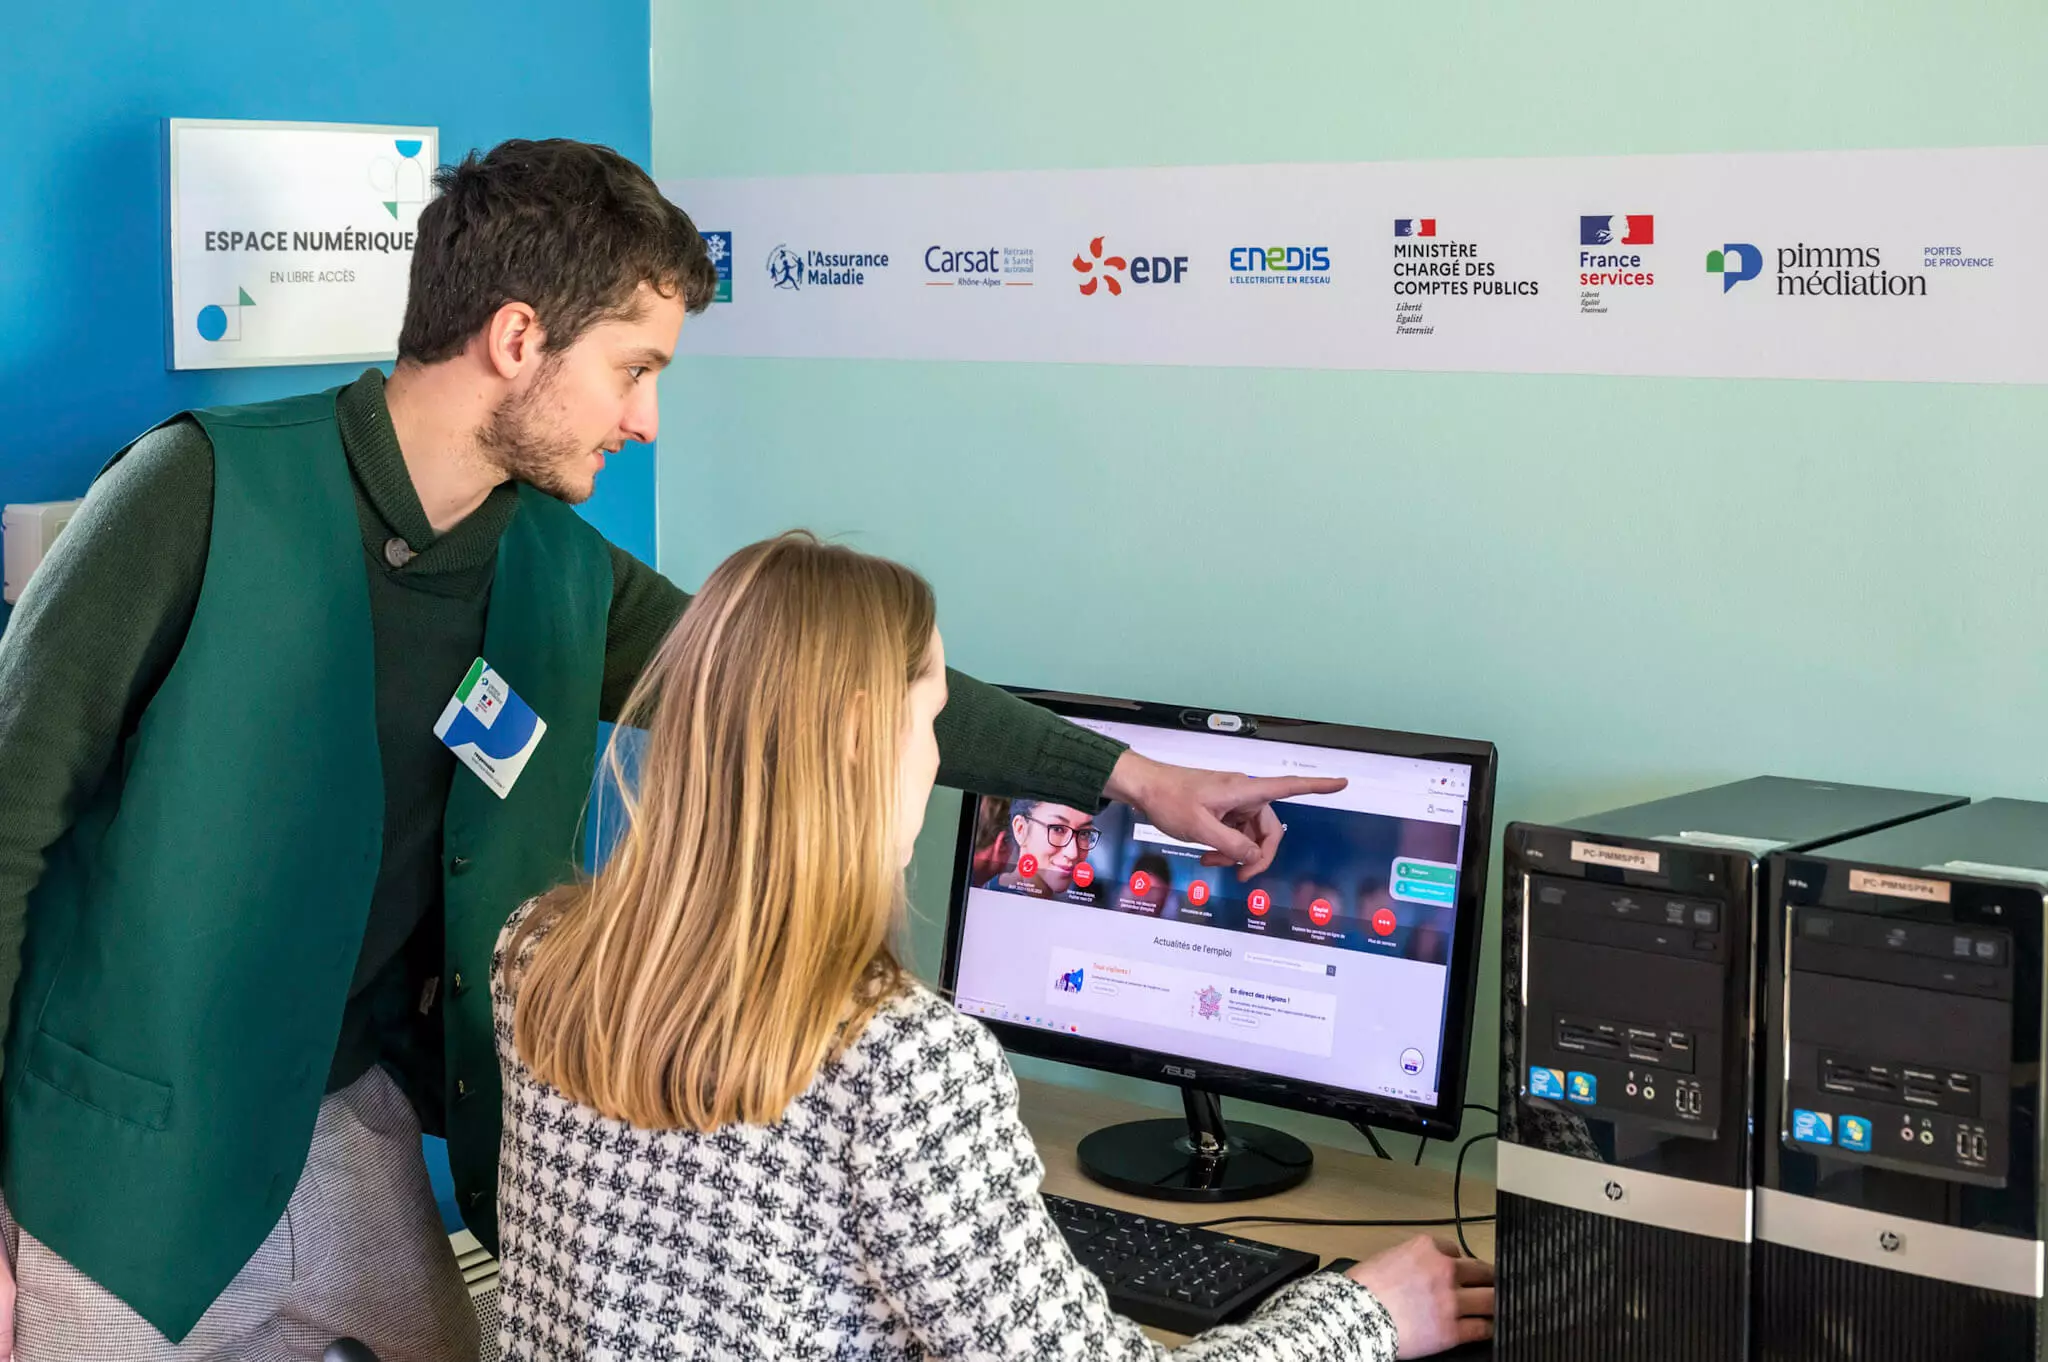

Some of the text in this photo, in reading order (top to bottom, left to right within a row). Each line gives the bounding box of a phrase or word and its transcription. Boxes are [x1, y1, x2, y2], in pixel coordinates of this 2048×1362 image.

[204, 225, 414, 254] ESPACE NUMÉRIQUE
[1393, 240, 1478, 258] MINISTÈRE
[1924, 246, 1962, 256] PORTES
[807, 250, 889, 267] l'Assurance
[924, 245, 999, 273] Carsat
[1580, 251, 1641, 268] France
[1777, 243, 1881, 273] pimms
[1924, 257, 1995, 268] DE PROVENCE
[1393, 259, 1496, 277] CHARGÉ DES
[269, 270, 356, 283] EN LIBRE ACCÈS
[808, 269, 865, 285] Maladie
[957, 277, 1001, 288] Rhône-Alpes
[1286, 275, 1298, 285] EN
[1579, 268, 1655, 286] services
[1777, 270, 1928, 296] médiation
[1393, 281, 1539, 296] COMPTES PUBLICS
[1395, 302, 1423, 312] Liberté
[1395, 312, 1424, 325] Égalité
[1395, 325, 1435, 336] Fraternité
[1153, 936, 1232, 958] Actualités de l'emploi
[1238, 988, 1254, 998] direct
[1254, 991, 1265, 1000] des
[1160, 1064, 1197, 1080] ASUS
